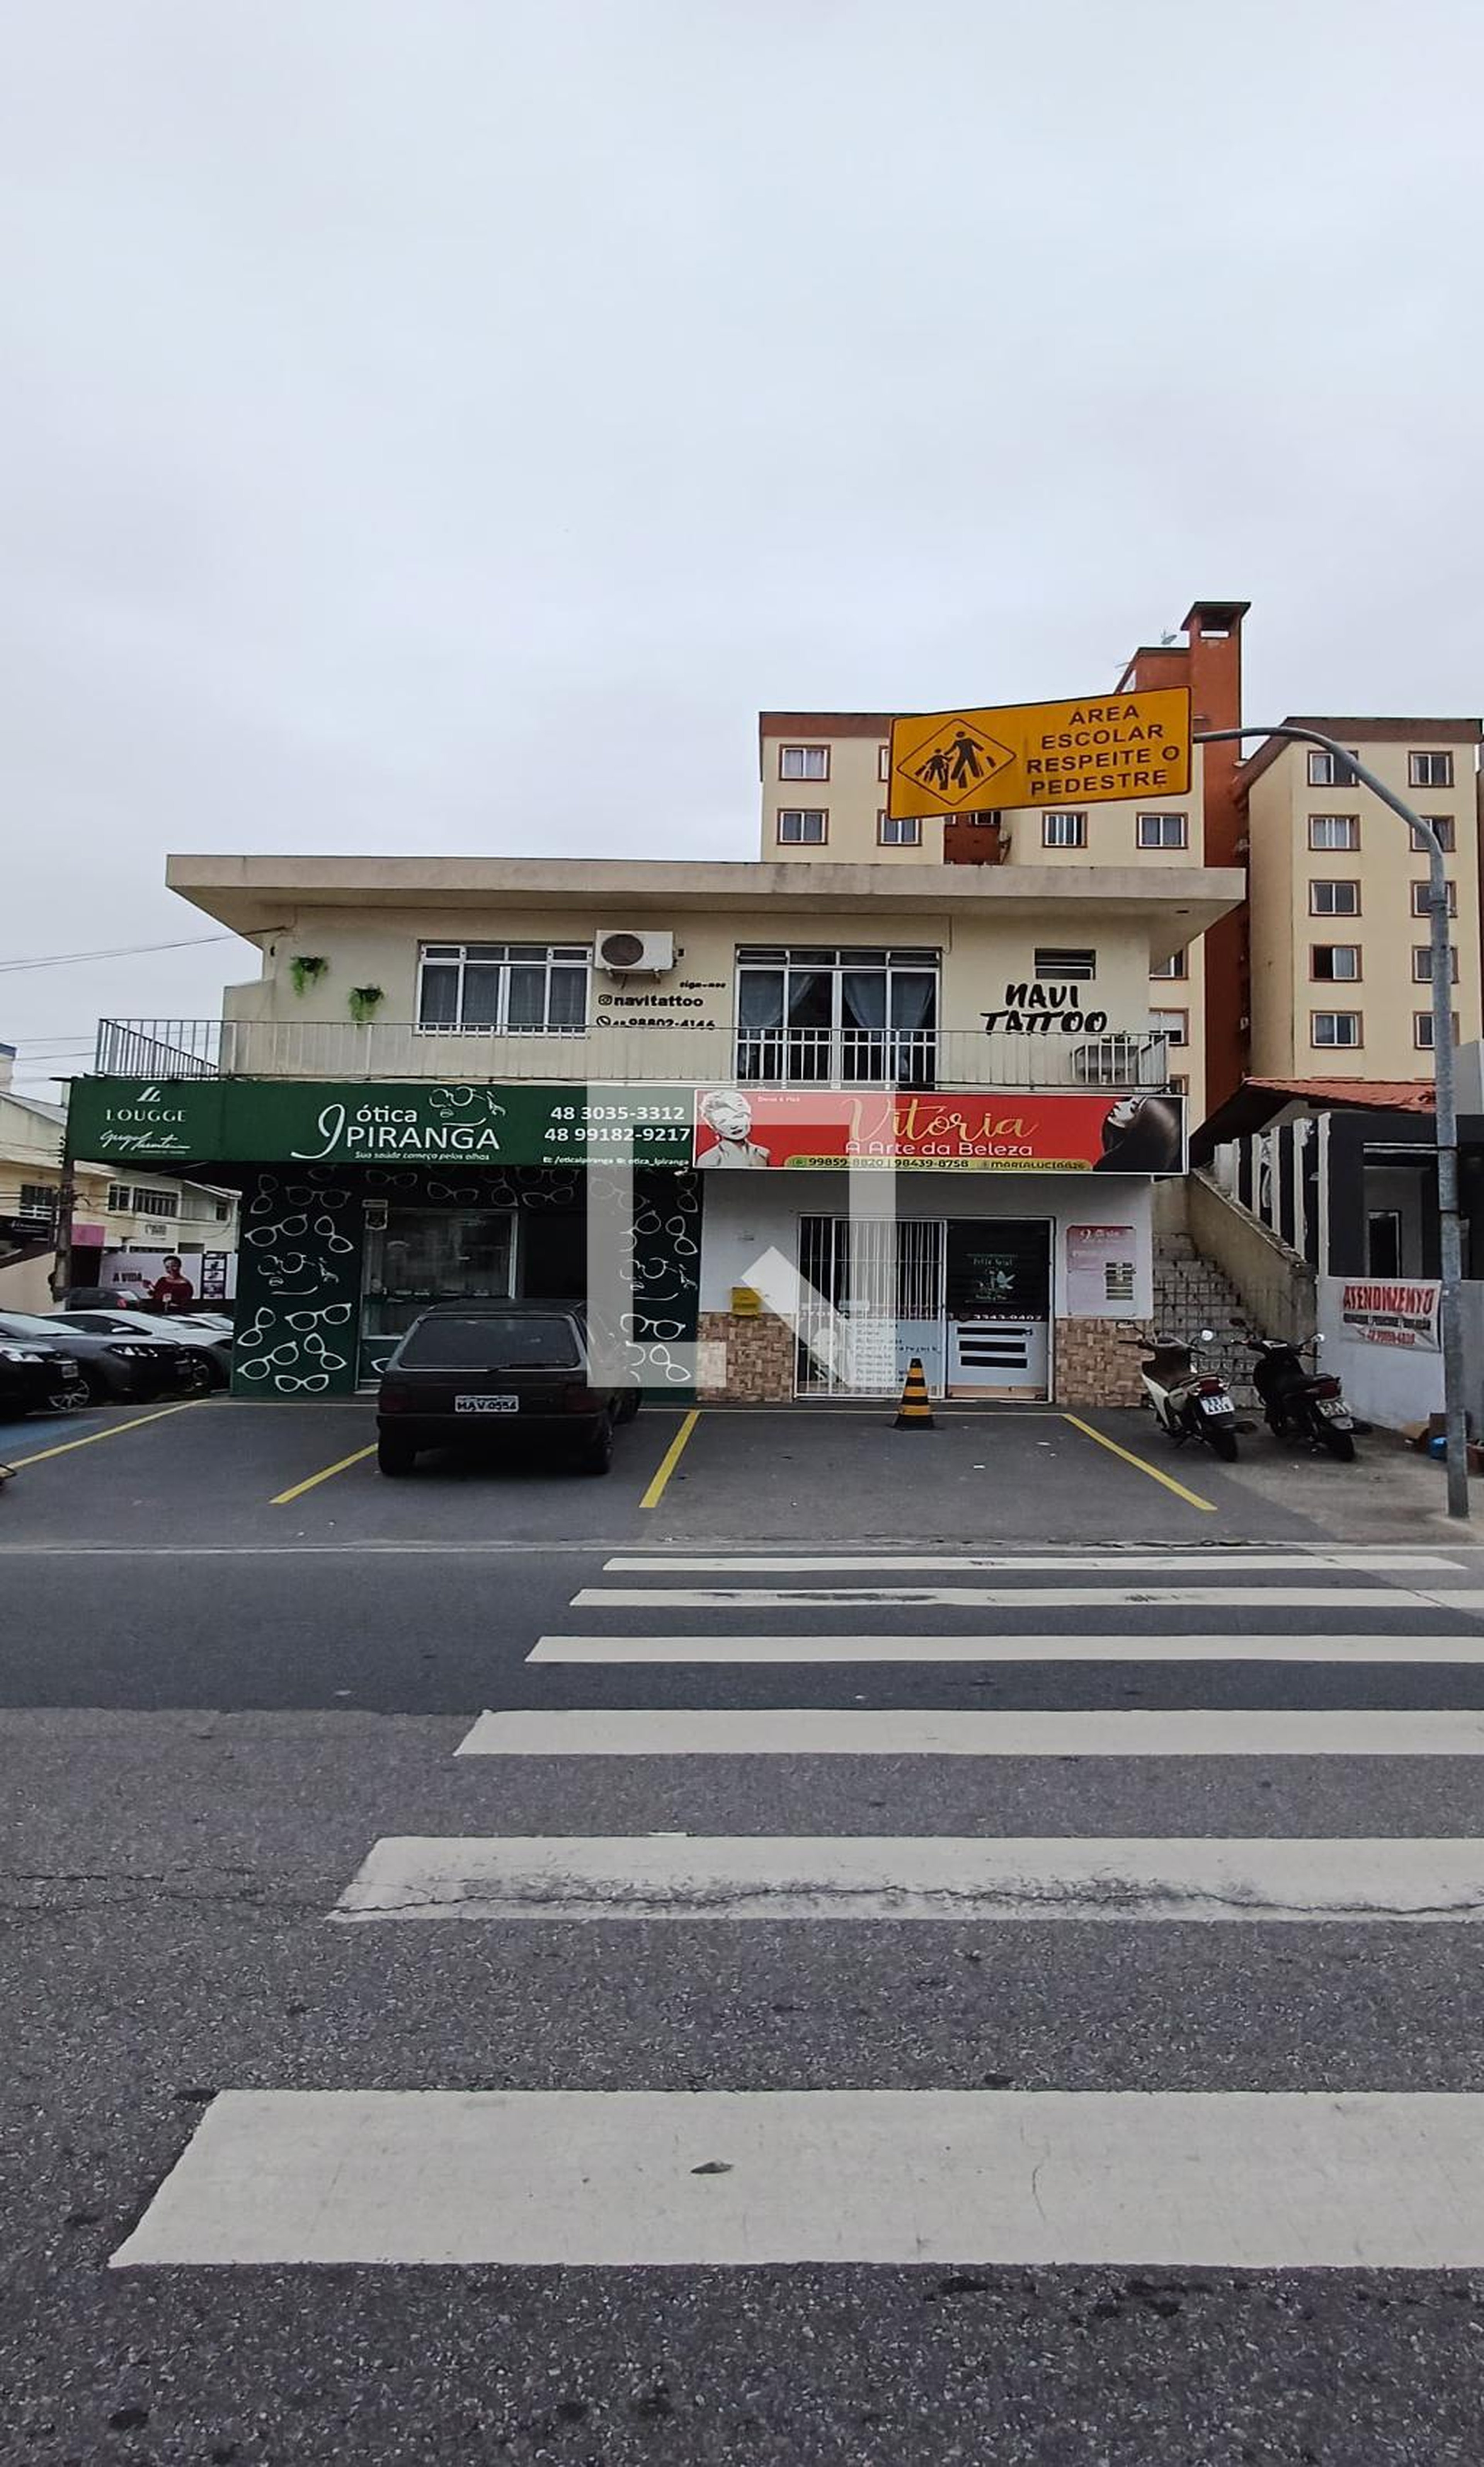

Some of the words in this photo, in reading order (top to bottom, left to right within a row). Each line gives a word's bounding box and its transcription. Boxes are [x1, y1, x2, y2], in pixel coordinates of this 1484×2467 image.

[1042, 724, 1163, 749] ESCOLAR
[1027, 748, 1150, 774] RESPEITE
[1162, 746, 1179, 761] O
[1031, 770, 1167, 795] PEDESTRE
[1006, 983, 1079, 1008] NAVI
[980, 1010, 1107, 1035] TATTOO
[106, 1109, 186, 1122] LOUGGE
[357, 1104, 418, 1123] ótica
[550, 1107, 575, 1120] 48
[580, 1107, 685, 1120] 3035-3312
[842, 1098, 1039, 1143] Vitória
[544, 1128, 569, 1141] 48
[574, 1128, 691, 1141] 99182-9217
[845, 1141, 859, 1155] A
[869, 1141, 916, 1156] Arte
[921, 1142, 951, 1156] da
[958, 1142, 1033, 1156] Beleza
